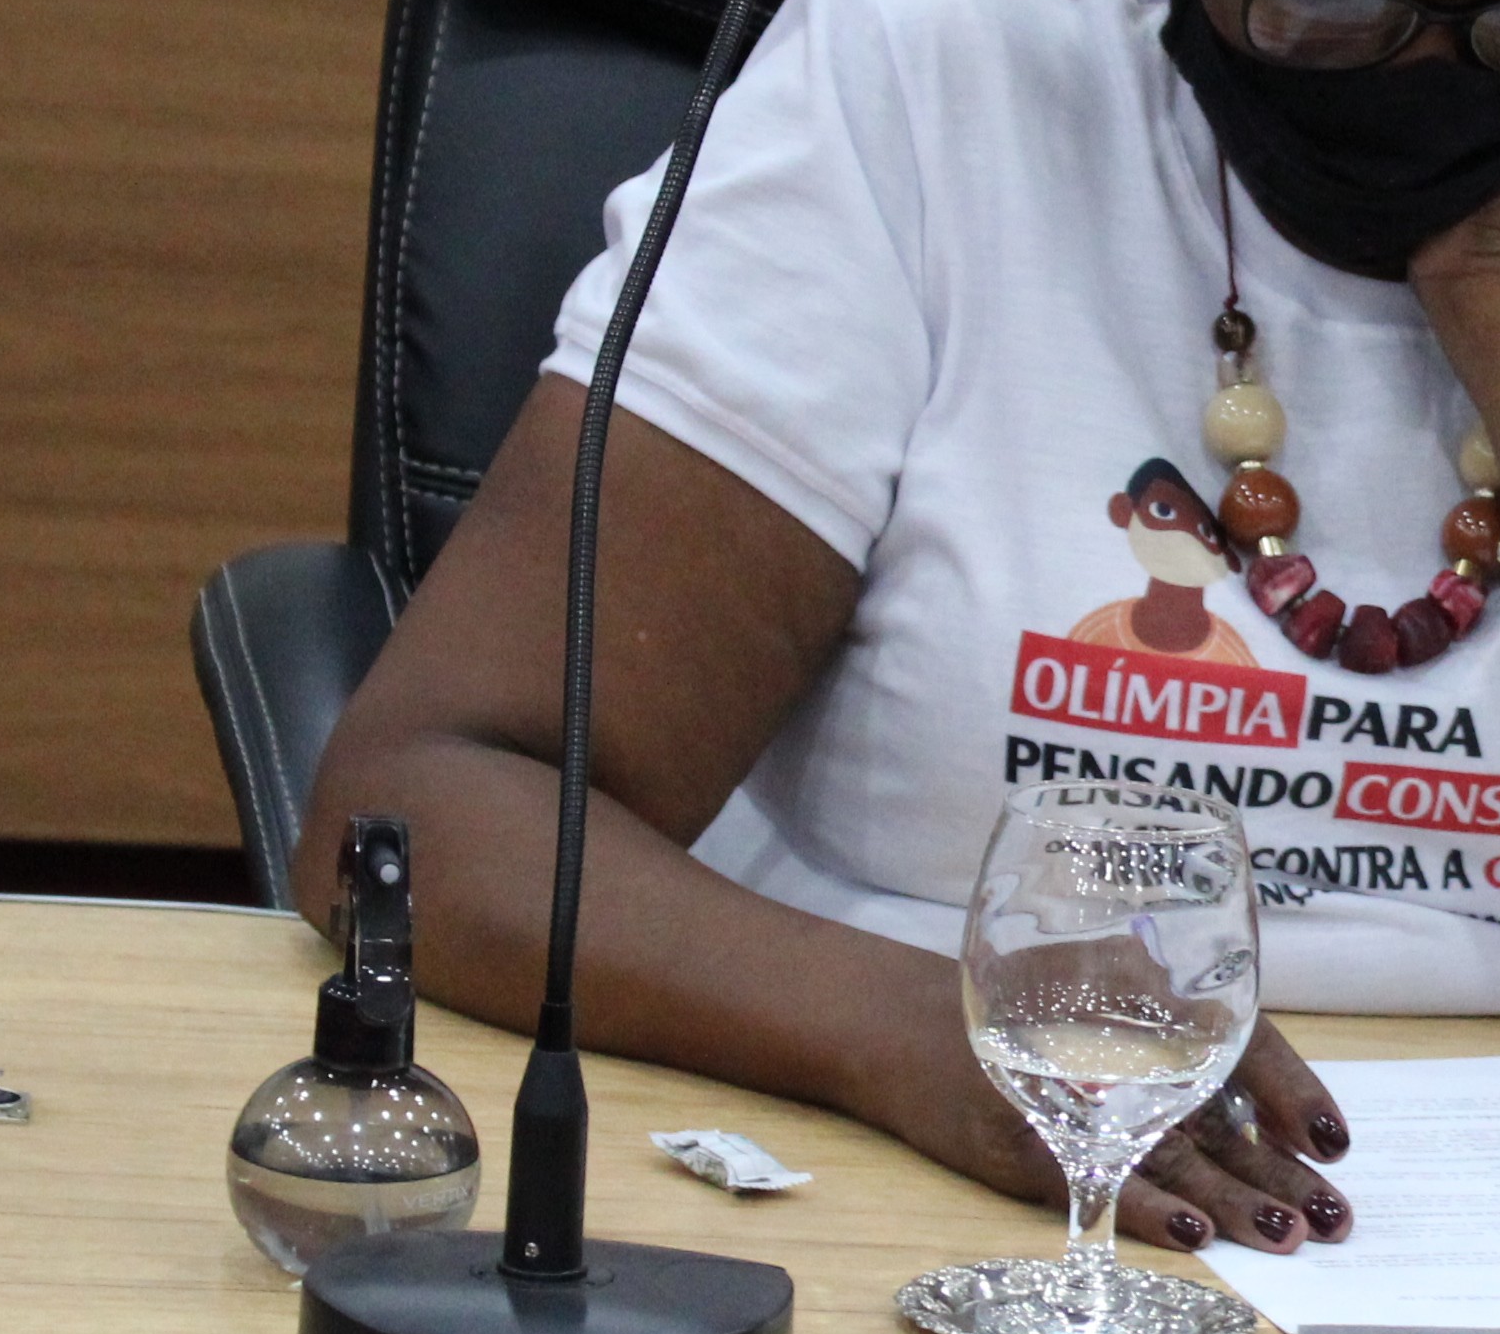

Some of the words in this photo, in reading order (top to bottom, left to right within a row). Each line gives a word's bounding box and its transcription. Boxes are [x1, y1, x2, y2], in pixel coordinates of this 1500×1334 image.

[1023, 657, 1287, 738] OLÍMPIA
[1306, 694, 1482, 758] PARA
[1004, 734, 1334, 809] PENSANDO
[1443, 848, 1472, 890] A
